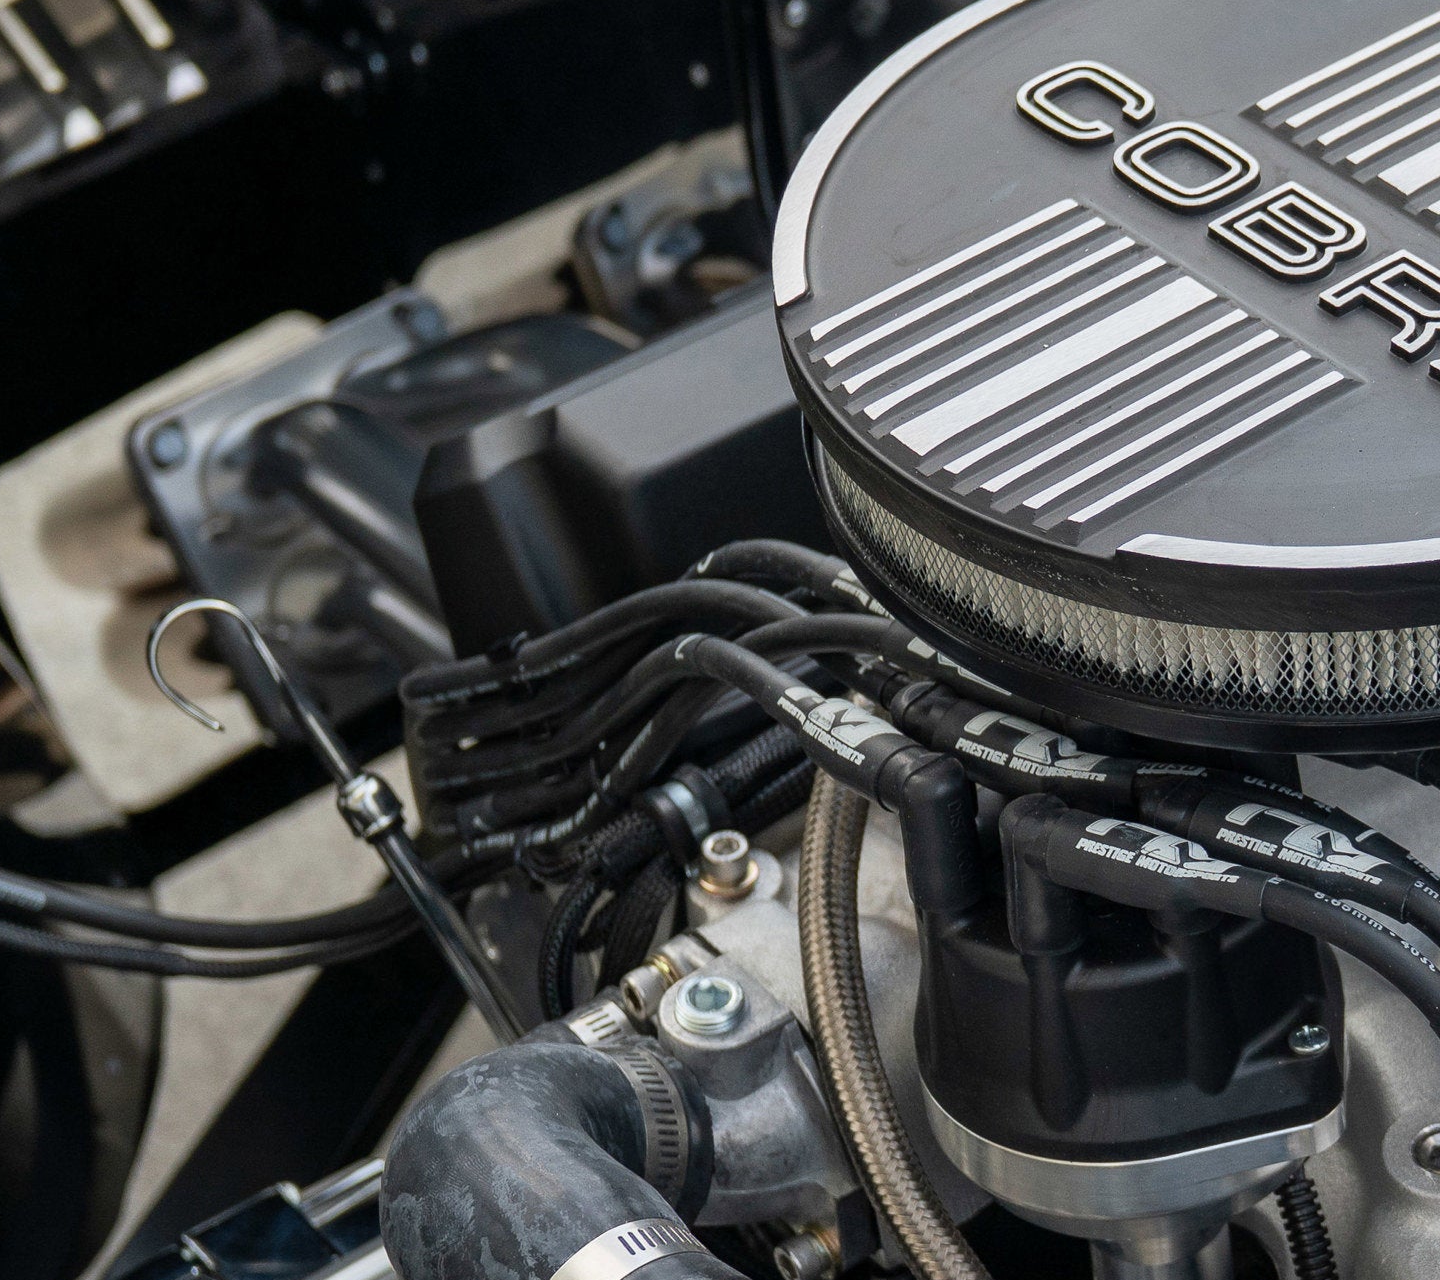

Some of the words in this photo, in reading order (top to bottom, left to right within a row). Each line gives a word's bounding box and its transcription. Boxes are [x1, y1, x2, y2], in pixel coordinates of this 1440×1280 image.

[802, 720, 866, 766] MOTORSPORTS
[955, 737, 1009, 767] PRESTIGE
[1009, 755, 1108, 783] MOTORSPORTS
[1075, 837, 1135, 864] PRESTIGE
[1133, 851, 1240, 884] MOTORSPORTS
[1216, 826, 1279, 860] PRESTIGE
[1278, 849, 1384, 887] MOTORSPORTS
